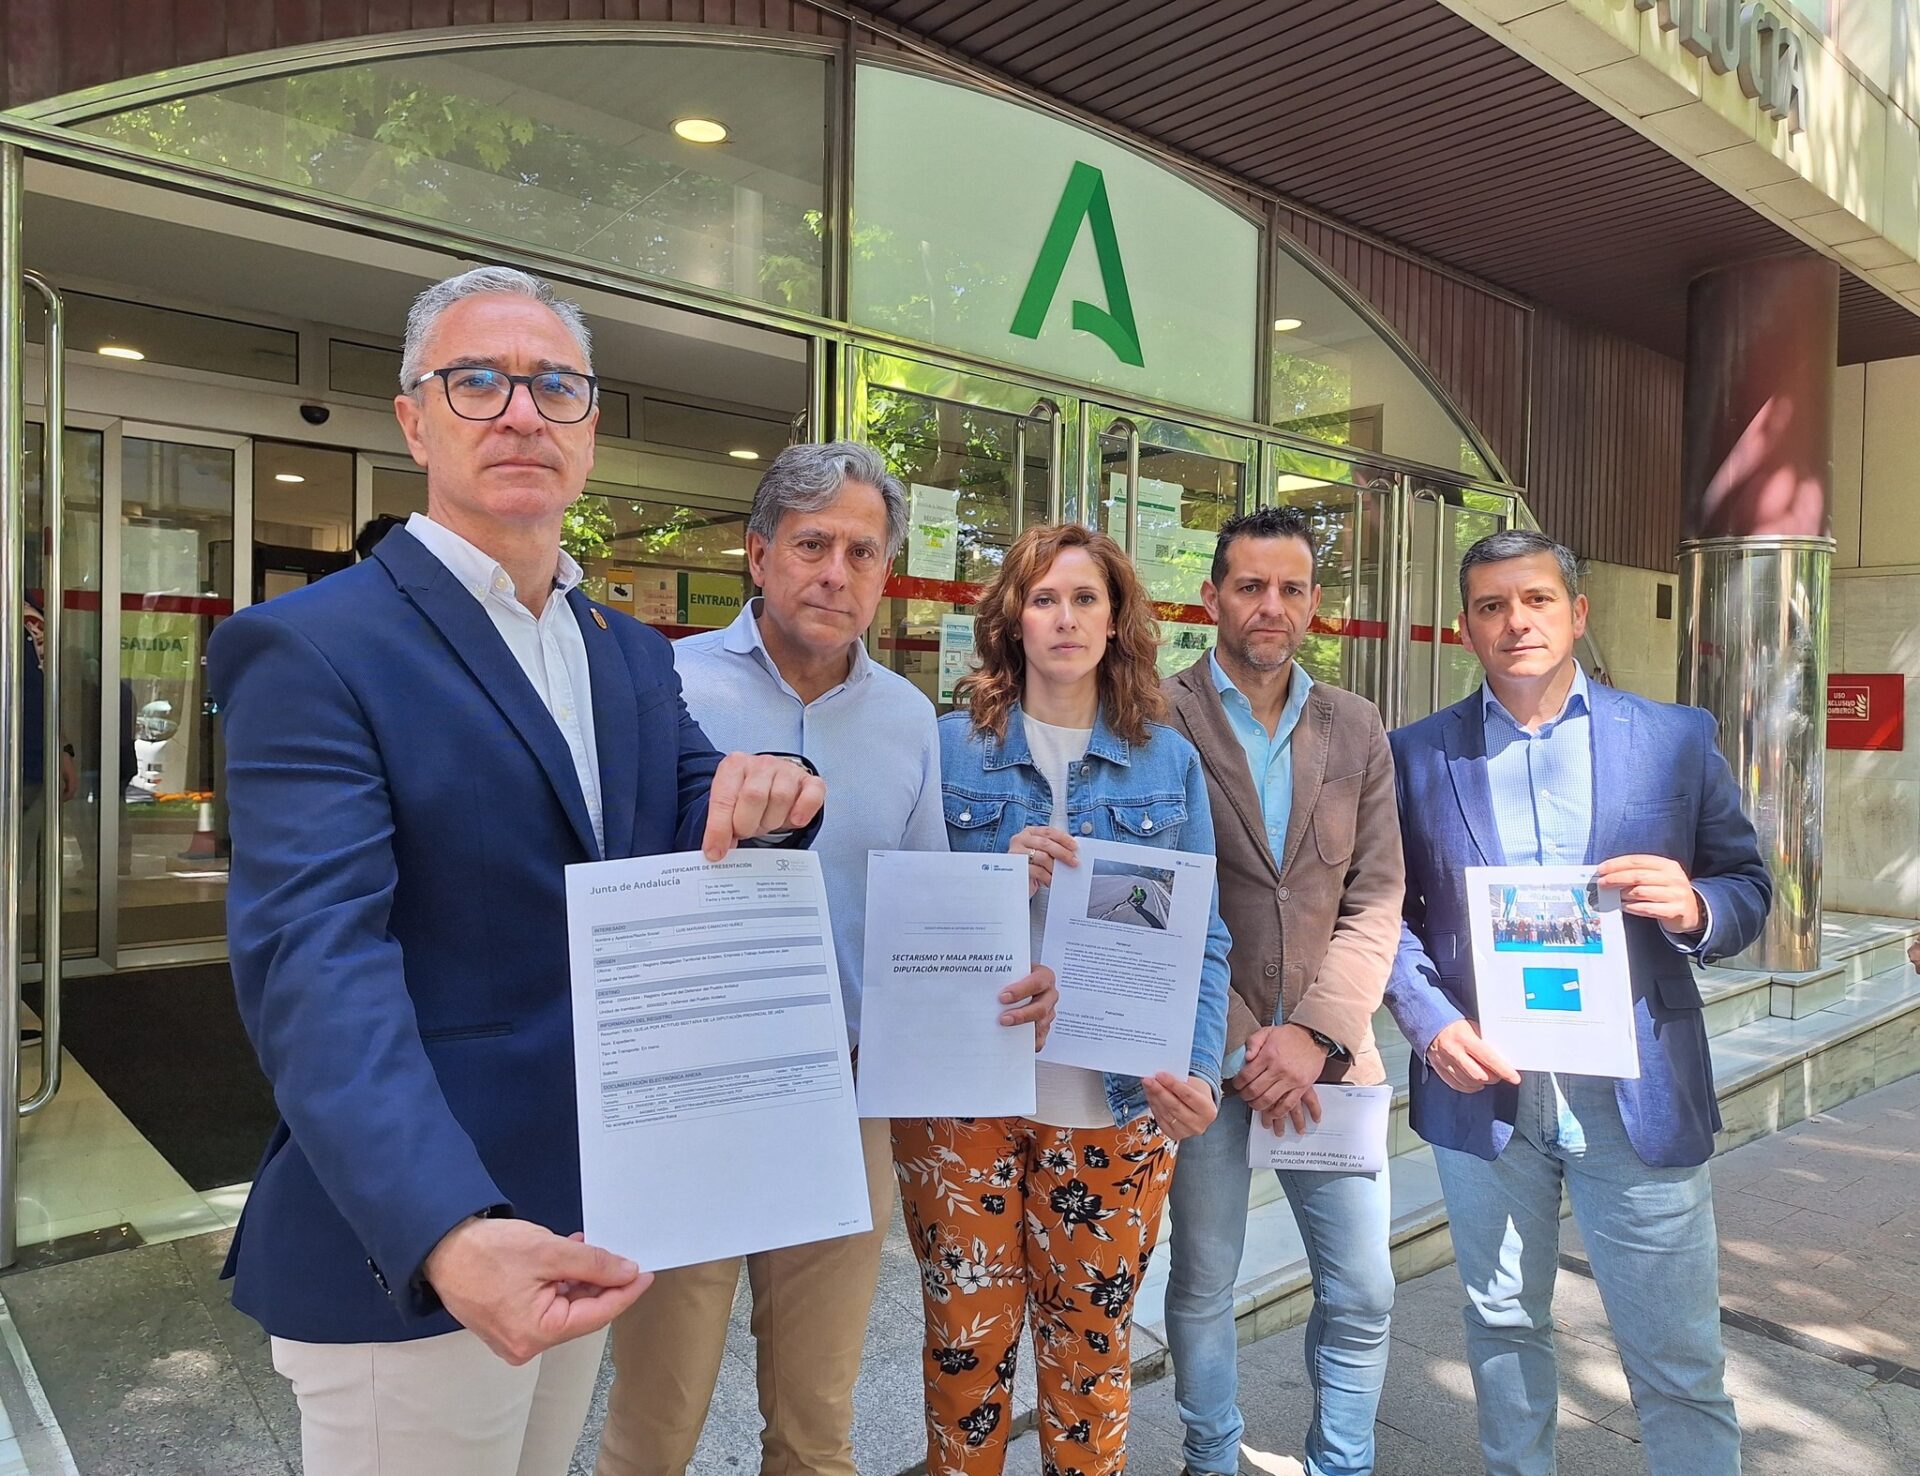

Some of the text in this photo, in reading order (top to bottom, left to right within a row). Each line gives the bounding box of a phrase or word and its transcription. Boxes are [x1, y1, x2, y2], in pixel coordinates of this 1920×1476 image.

[690, 593, 740, 608] ENTRADA
[120, 636, 182, 652] SALIDA
[661, 866, 700, 874] JUSTIFICANTE
[590, 877, 680, 895] Junta de Andalucía
[894, 964, 938, 972] DIPUTACIÓN
[995, 964, 1011, 972] JAÉN
